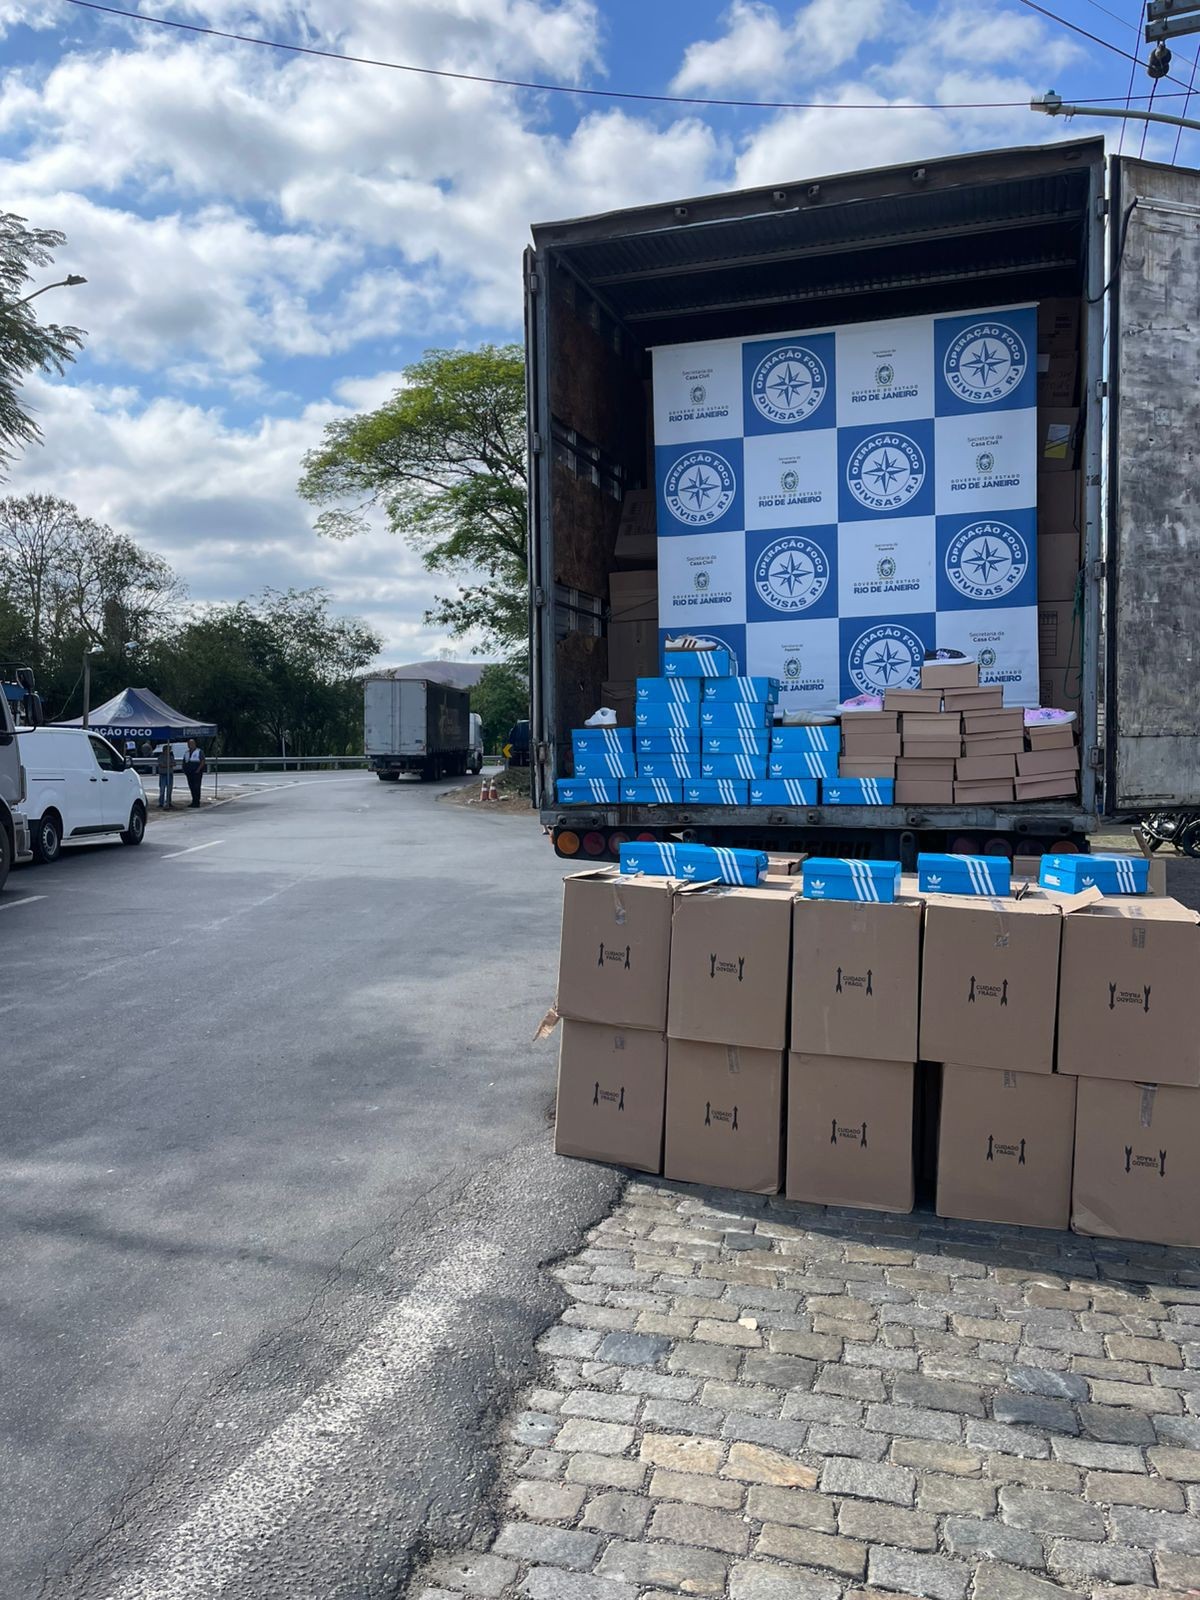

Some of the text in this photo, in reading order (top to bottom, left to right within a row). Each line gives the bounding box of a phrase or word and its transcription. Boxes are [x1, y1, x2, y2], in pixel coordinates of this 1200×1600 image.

[950, 327, 1021, 367] OPERAÇÃO FOCO
[757, 351, 821, 389] OPERAÇÃO FOCO
[952, 374, 1002, 399] DIVISAS
[1007, 368, 1020, 384] RJ
[759, 390, 820, 420] DIVISAS RJ
[852, 390, 918, 403] RIO DE JANEIRO
[669, 414, 682, 422] RIO
[695, 410, 728, 419] JANEIRO
[852, 436, 919, 475] OPERAÇÃO FOCO
[669, 454, 730, 492] OPERAÇÃO FOCO
[951, 483, 966, 491] RIO
[982, 479, 1020, 488] JANEIRO
[759, 500, 773, 508] RIO
[786, 496, 822, 505] JANEIRO
[854, 476, 919, 506] DIVISAS RJ
[671, 493, 730, 522] DIVISAS RJ
[951, 525, 1021, 563] OPERAÇÃO FOCO
[759, 540, 823, 577] OPERAÇÃO FOCO
[762, 580, 822, 608] DIVISAS RJ
[854, 583, 920, 594] RIO DE JANEIRO
[953, 566, 1021, 596] DIVISAS RJ
[699, 596, 732, 604] JANEIRO
[853, 628, 921, 664] OPERAÇÃO FOCO
[906, 668, 920, 685] RJ
[983, 675, 1022, 683] JANEIRO
[124, 728, 152, 736] FOCO
[837, 1127, 861, 1135] CUIDADO
[994, 1143, 1019, 1152] CUIDADO
